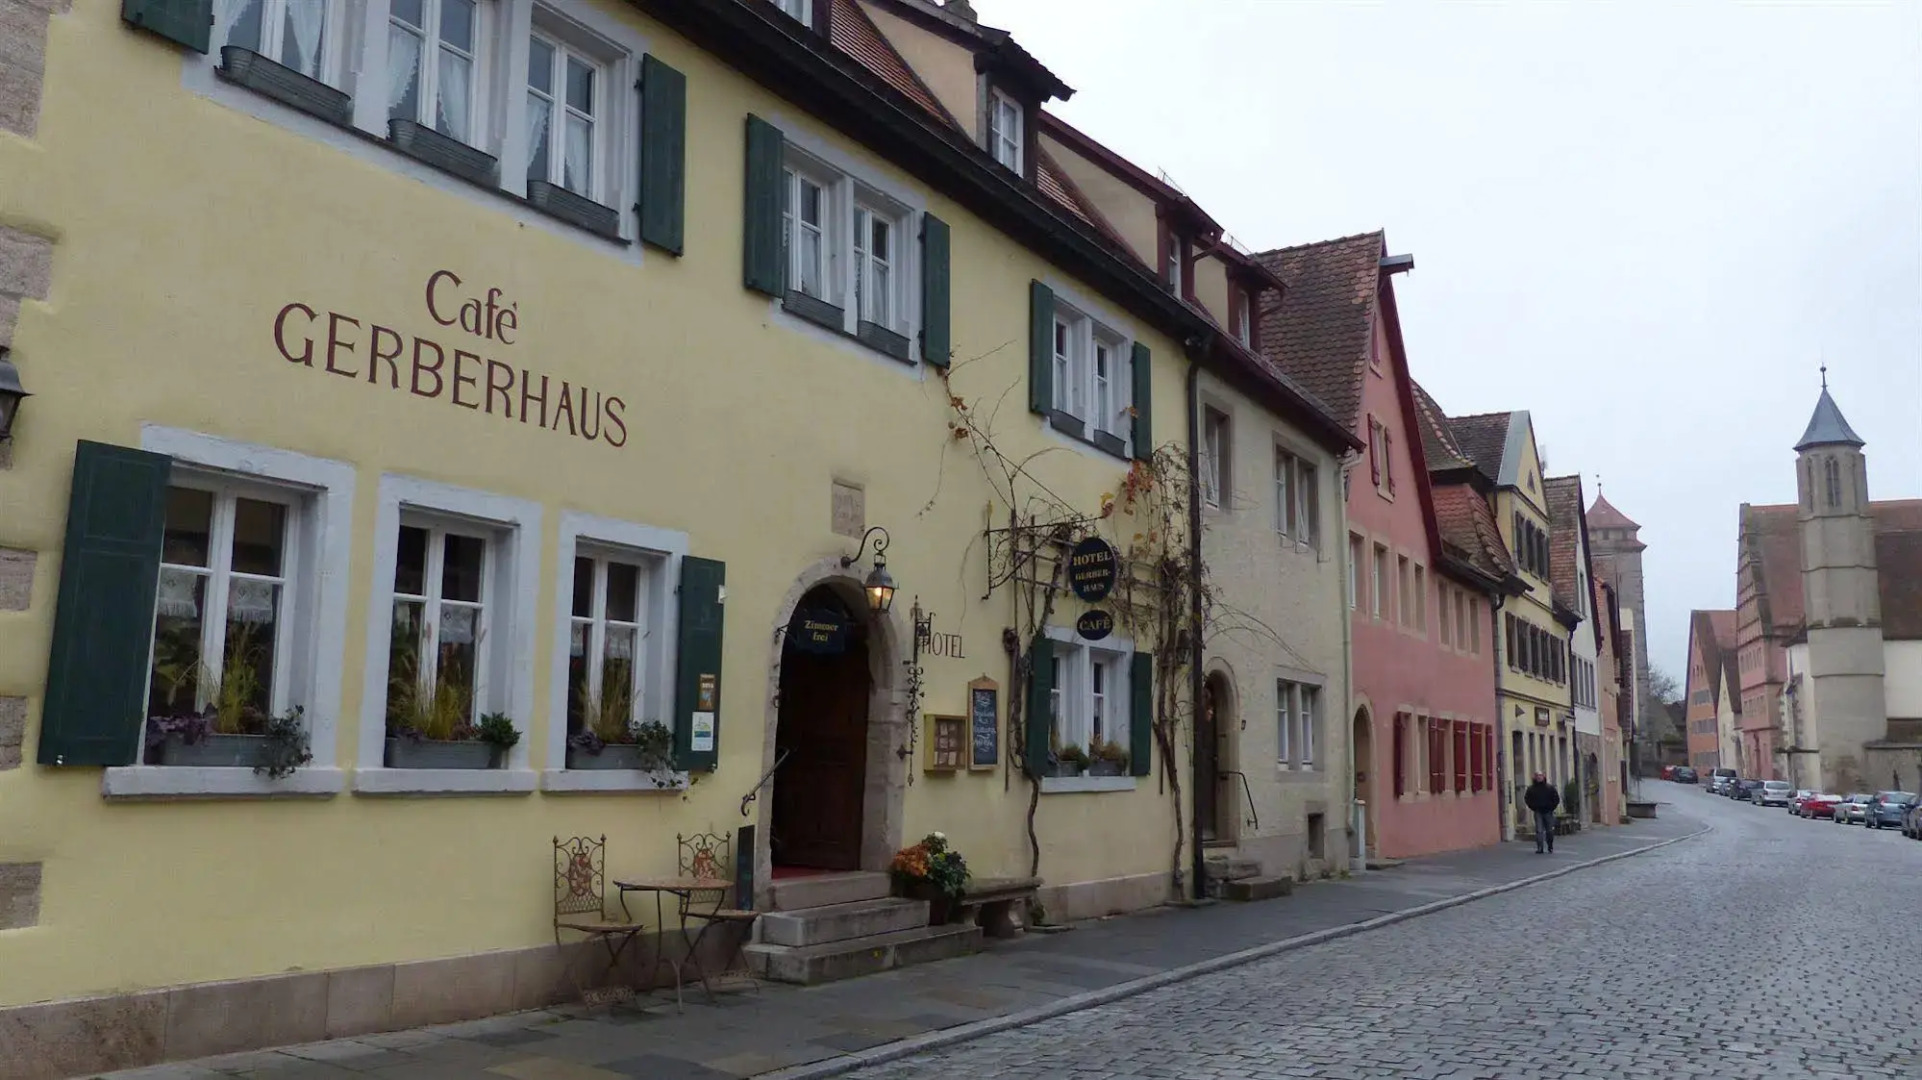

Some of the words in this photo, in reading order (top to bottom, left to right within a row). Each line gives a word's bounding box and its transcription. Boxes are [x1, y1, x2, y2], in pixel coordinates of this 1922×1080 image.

[426, 270, 518, 345] Café
[274, 302, 627, 448] GERBERHAUS
[1073, 551, 1112, 566] HOTEL
[804, 620, 839, 631] Zimmer
[1080, 616, 1112, 632] CAFÉ
[813, 631, 829, 642] frei
[922, 631, 966, 659] HOTEL
